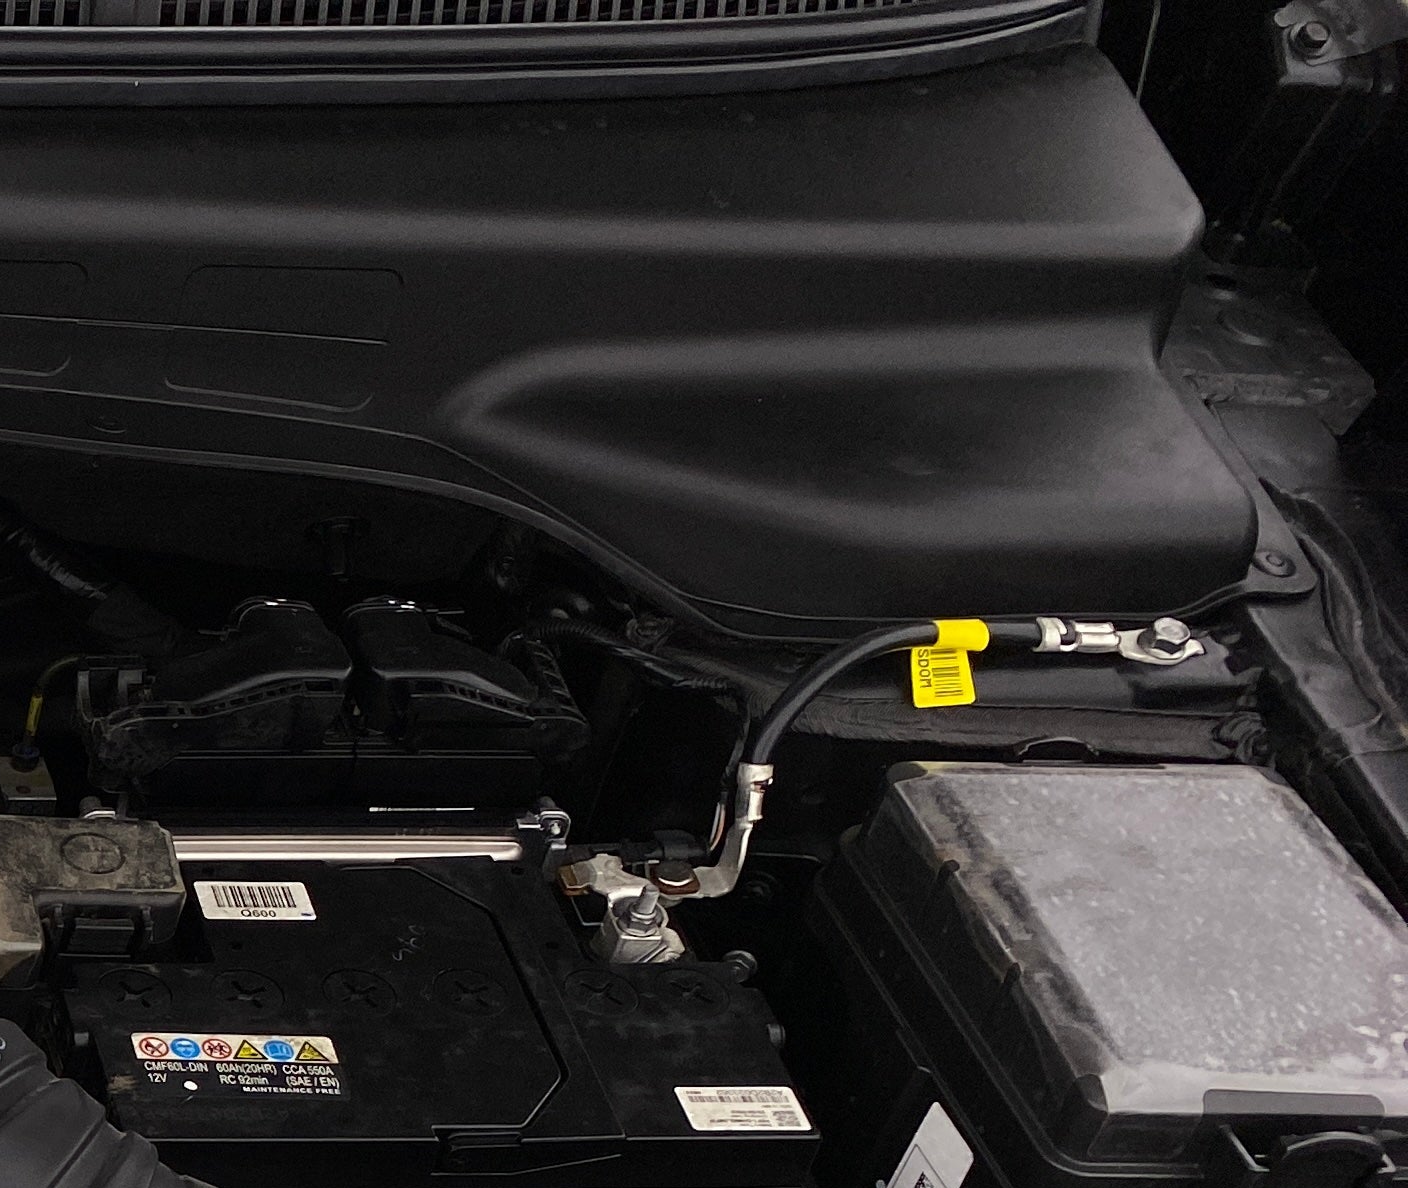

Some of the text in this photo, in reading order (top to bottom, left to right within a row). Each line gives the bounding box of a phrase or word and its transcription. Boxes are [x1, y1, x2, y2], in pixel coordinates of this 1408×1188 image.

[241, 909, 277, 918] Q600
[144, 1060, 334, 1076] CMF60L-DIN 60Ah(20HR) CCA 550A
[147, 1073, 167, 1083] 12V
[218, 1074, 236, 1084] RC
[238, 1075, 269, 1085] 92min
[285, 1076, 311, 1087] (SAE
[319, 1077, 339, 1088] EN)
[242, 1086, 341, 1095] MAINTENANCE FREE
